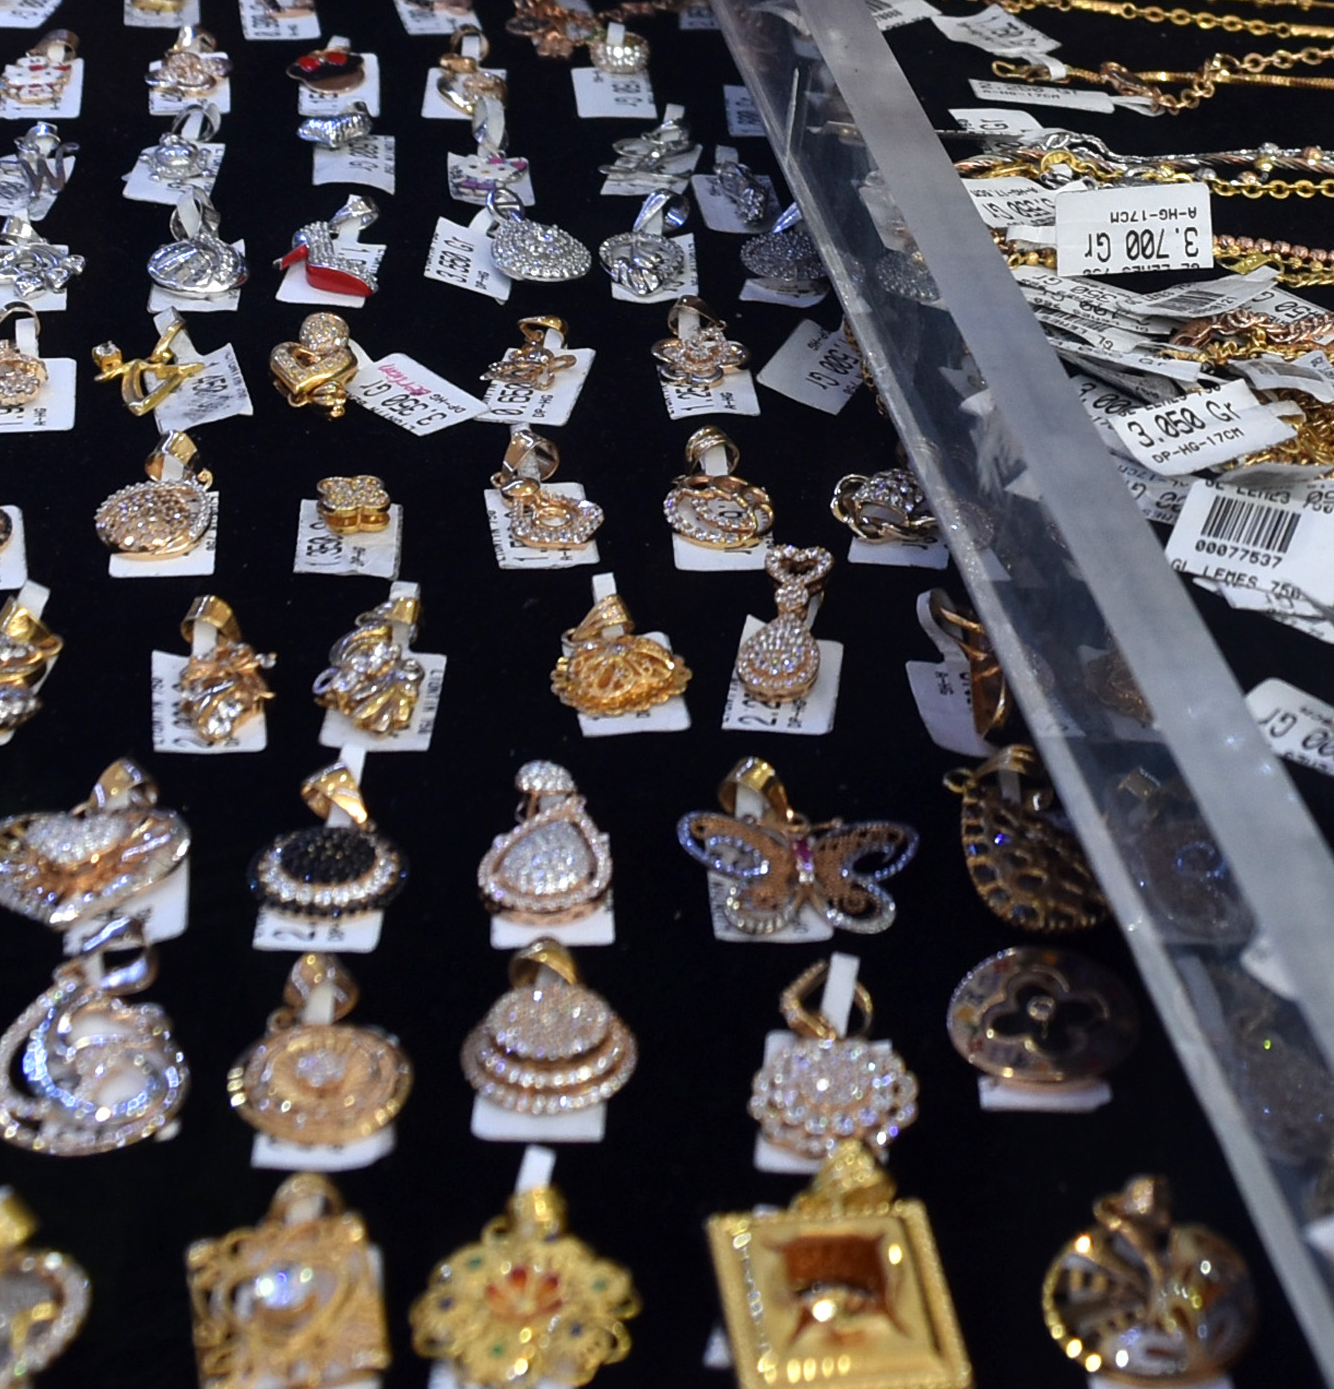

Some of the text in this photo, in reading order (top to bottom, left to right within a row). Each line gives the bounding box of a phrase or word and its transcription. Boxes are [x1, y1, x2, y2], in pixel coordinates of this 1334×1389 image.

[1108, 206, 1197, 223] A-HG-17CM
[433, 233, 476, 285] 3.550 Gr
[1082, 224, 1199, 262] 3.700 Gr
[474, 269, 491, 290] DP-HG
[34, 407, 46, 425] A-HG
[359, 377, 446, 428] 3.350 Gr
[430, 392, 465, 415] DP-HG
[491, 383, 534, 416] 0.650
[534, 394, 553, 418] DP-HG
[722, 392, 737, 409] A-HG
[1126, 398, 1239, 450] 3.050 Gr
[1151, 426, 1245, 465] DP-HG-17CM
[1193, 537, 1283, 570] 00077537
[1201, 565, 1259, 589] LEMES
[1259, 704, 1297, 740] Gr
